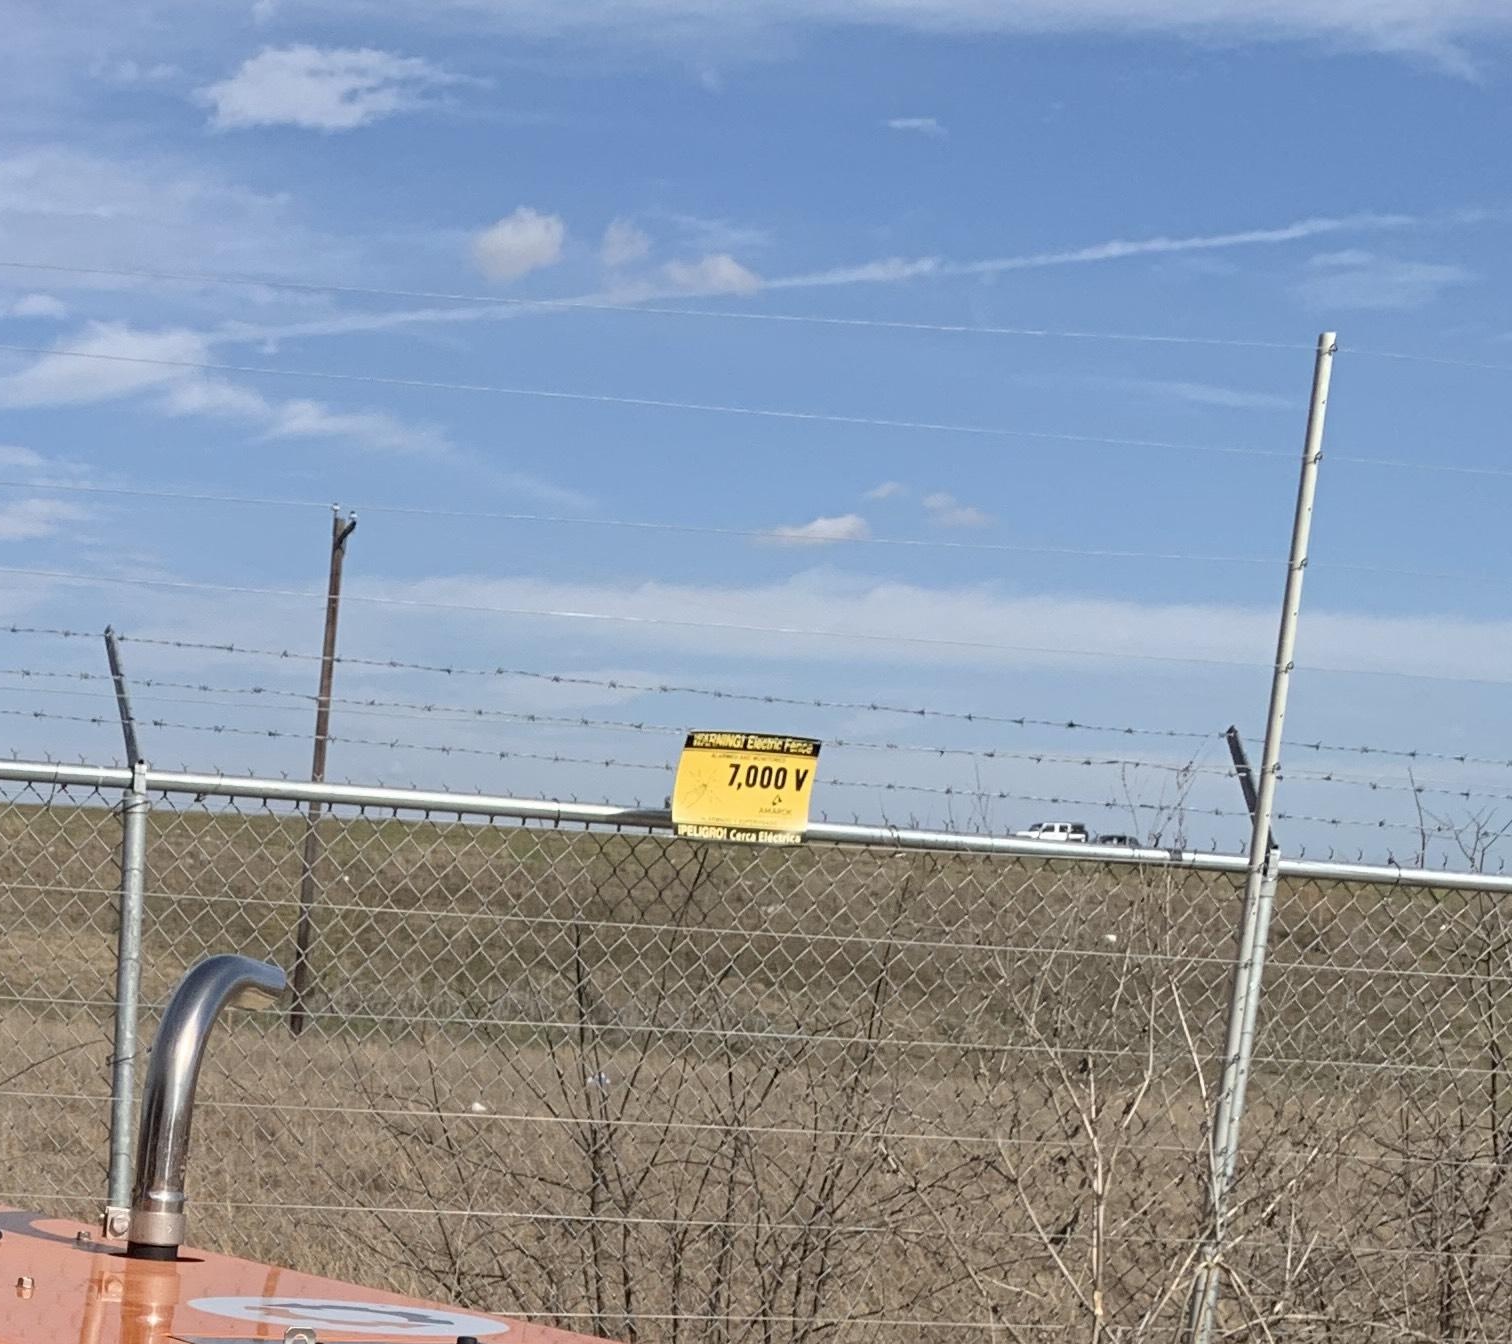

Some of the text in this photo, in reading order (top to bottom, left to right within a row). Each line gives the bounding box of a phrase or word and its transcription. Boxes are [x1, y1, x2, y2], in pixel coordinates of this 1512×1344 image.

[693, 733, 745, 749] WARNING!
[784, 739, 814, 754] Fence
[728, 763, 809, 791] 7,000 V
[729, 829, 756, 842] Cerca
